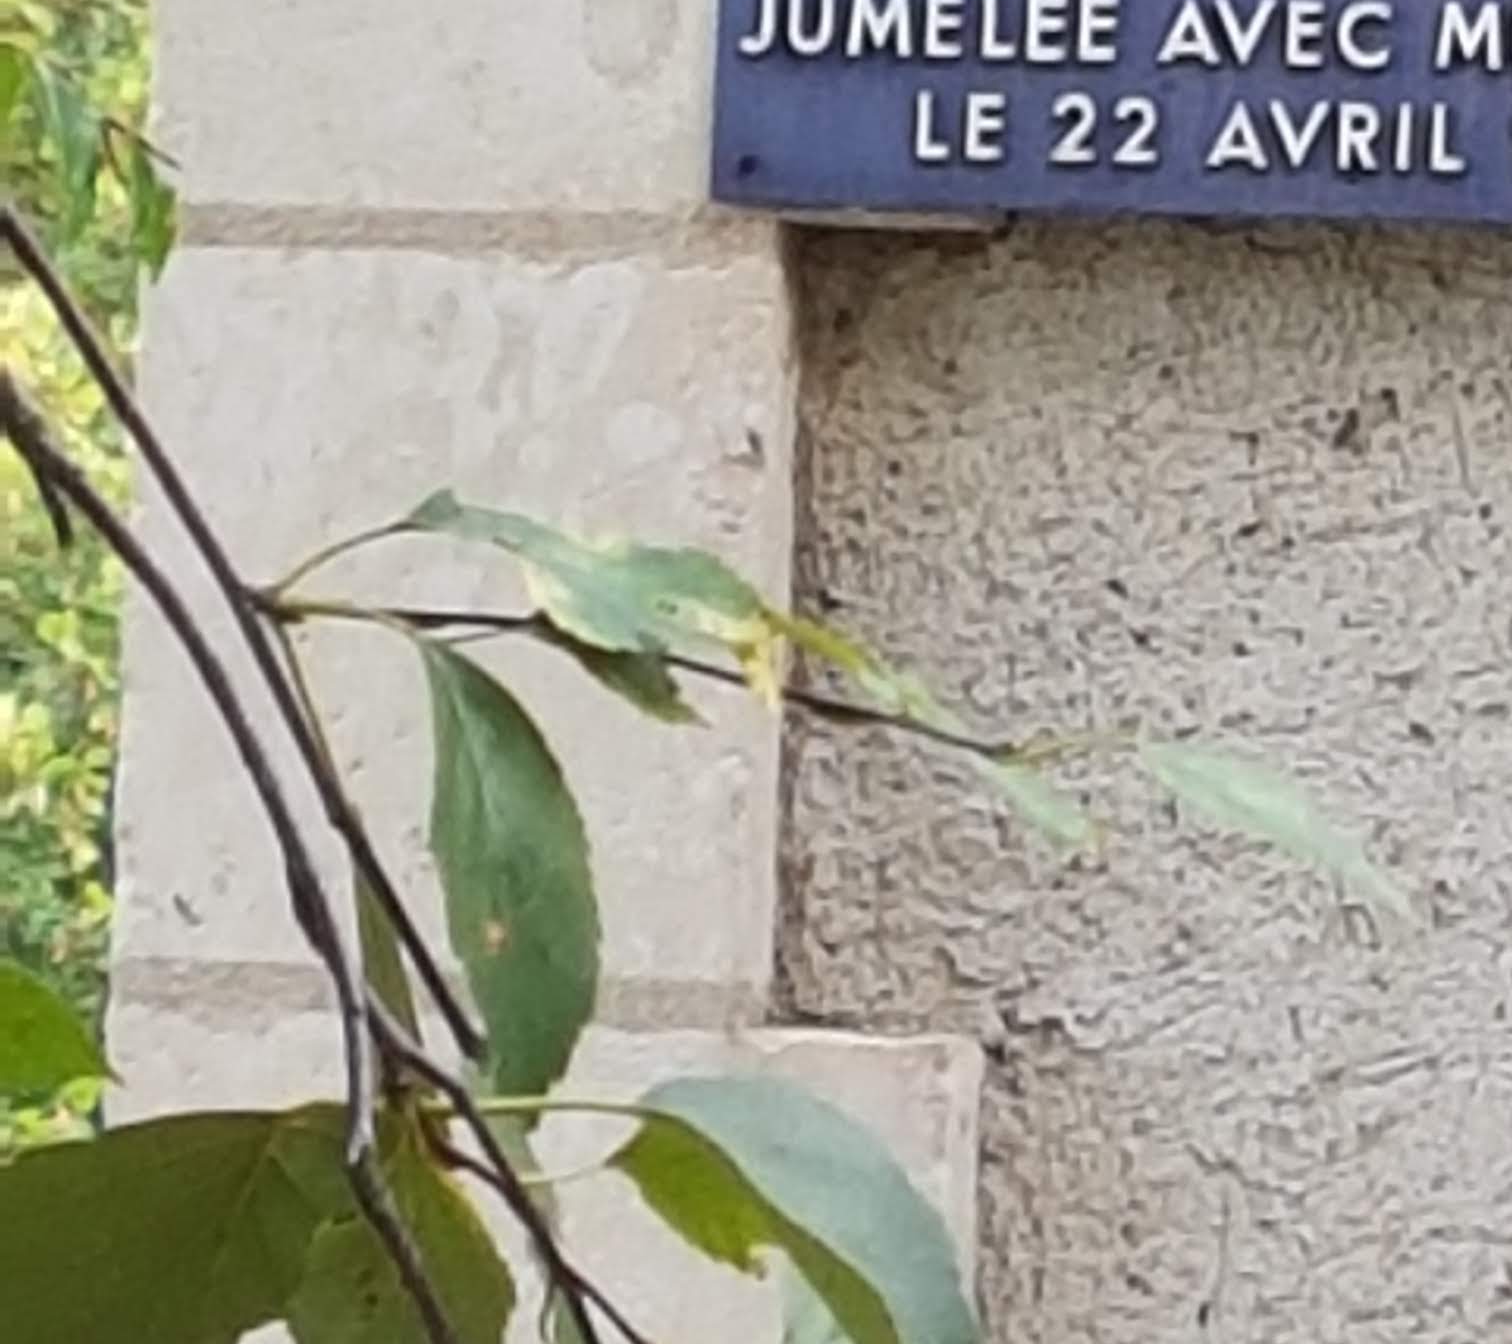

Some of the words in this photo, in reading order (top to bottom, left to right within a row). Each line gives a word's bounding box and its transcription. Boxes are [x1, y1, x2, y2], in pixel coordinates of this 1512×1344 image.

[914, 90, 1007, 162] LE
[1049, 92, 1158, 165] 22
[1206, 98, 1466, 173] AVRIL
